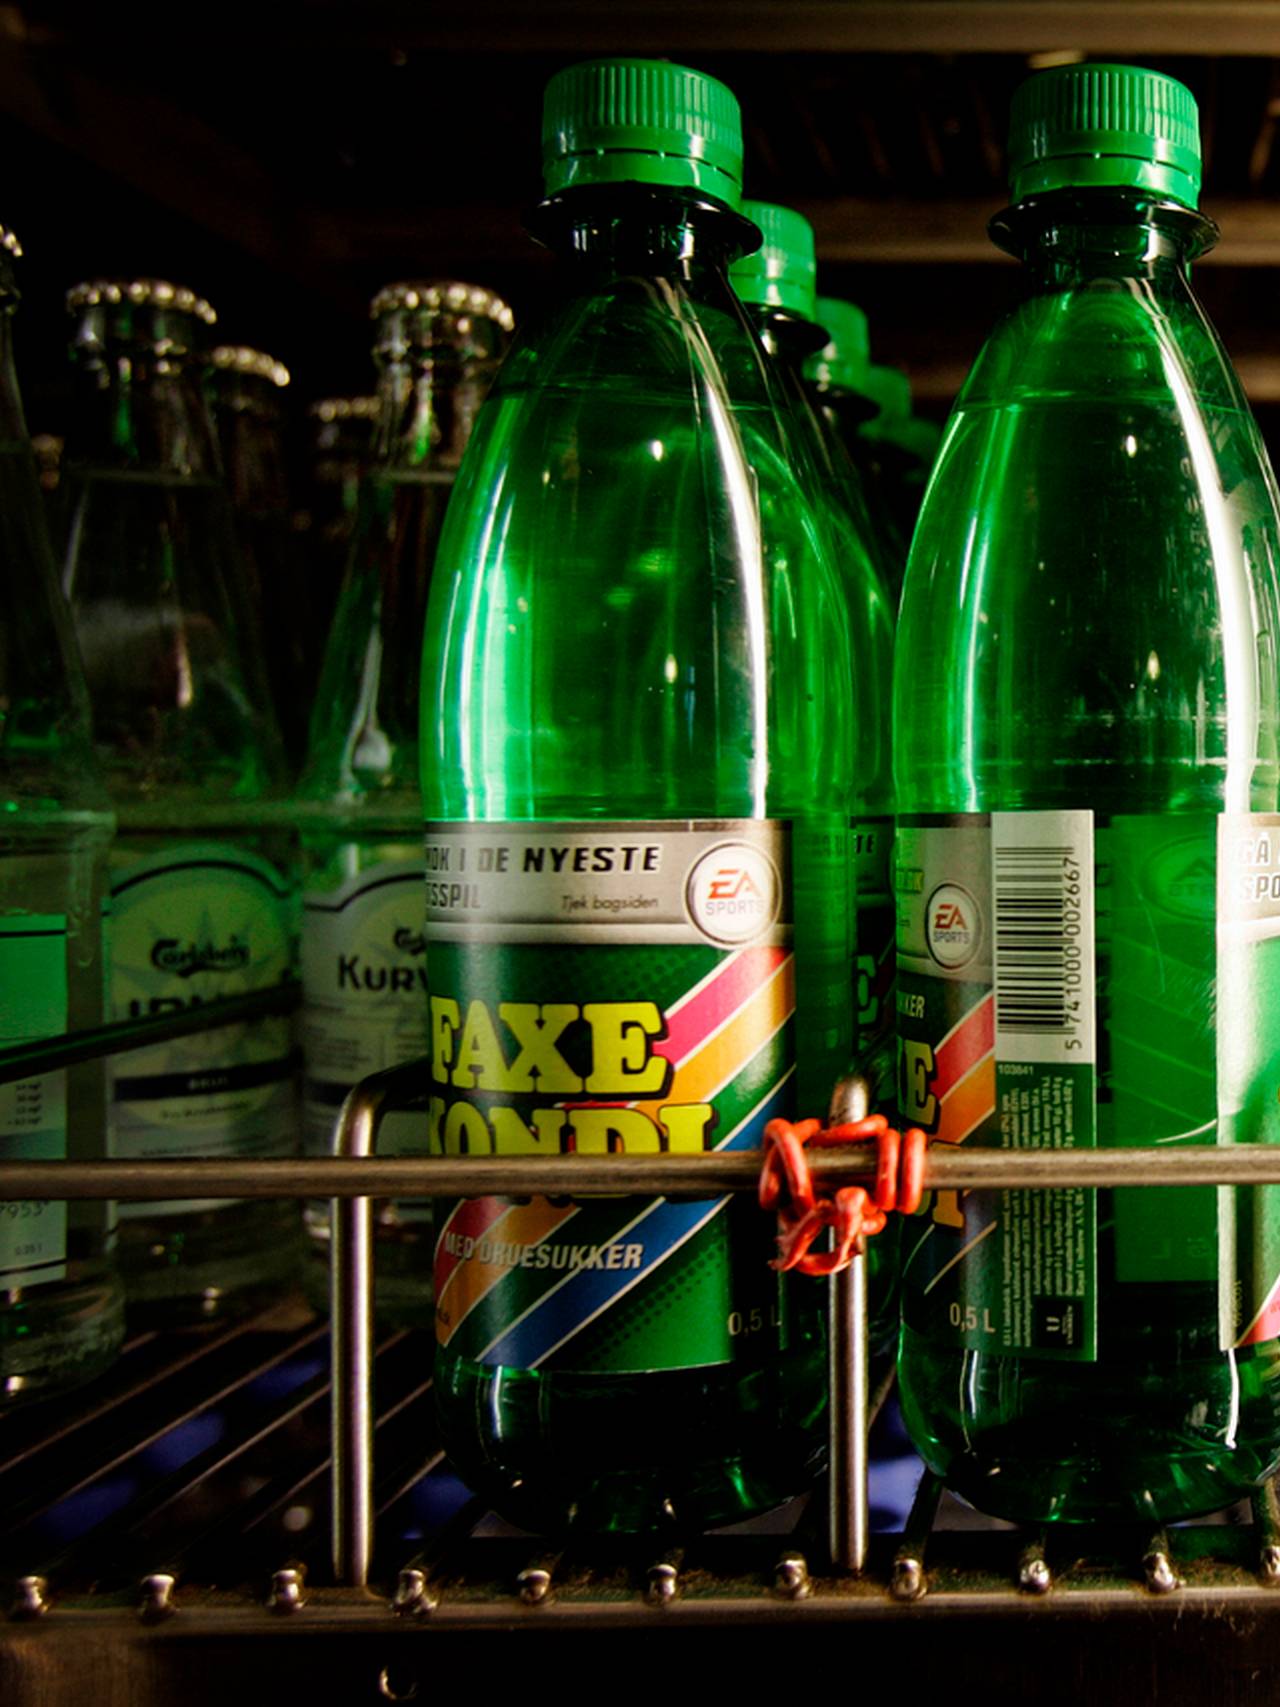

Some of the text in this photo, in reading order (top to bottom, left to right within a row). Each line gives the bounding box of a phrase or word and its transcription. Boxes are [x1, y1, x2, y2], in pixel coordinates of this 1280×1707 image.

[478, 847, 509, 872] DE
[523, 846, 661, 872] NYESTE
[708, 868, 763, 899] EA
[561, 893, 659, 913] Tjek bagsiden
[704, 900, 765, 916] SPORTS
[935, 904, 967, 930] EA
[933, 931, 970, 944] SPORTS
[431, 996, 663, 1093] FAXE
[445, 1231, 644, 1270] MED DRUESUKKER
[728, 1307, 763, 1339] 0,5
[949, 1302, 996, 1333] 0,5 L
